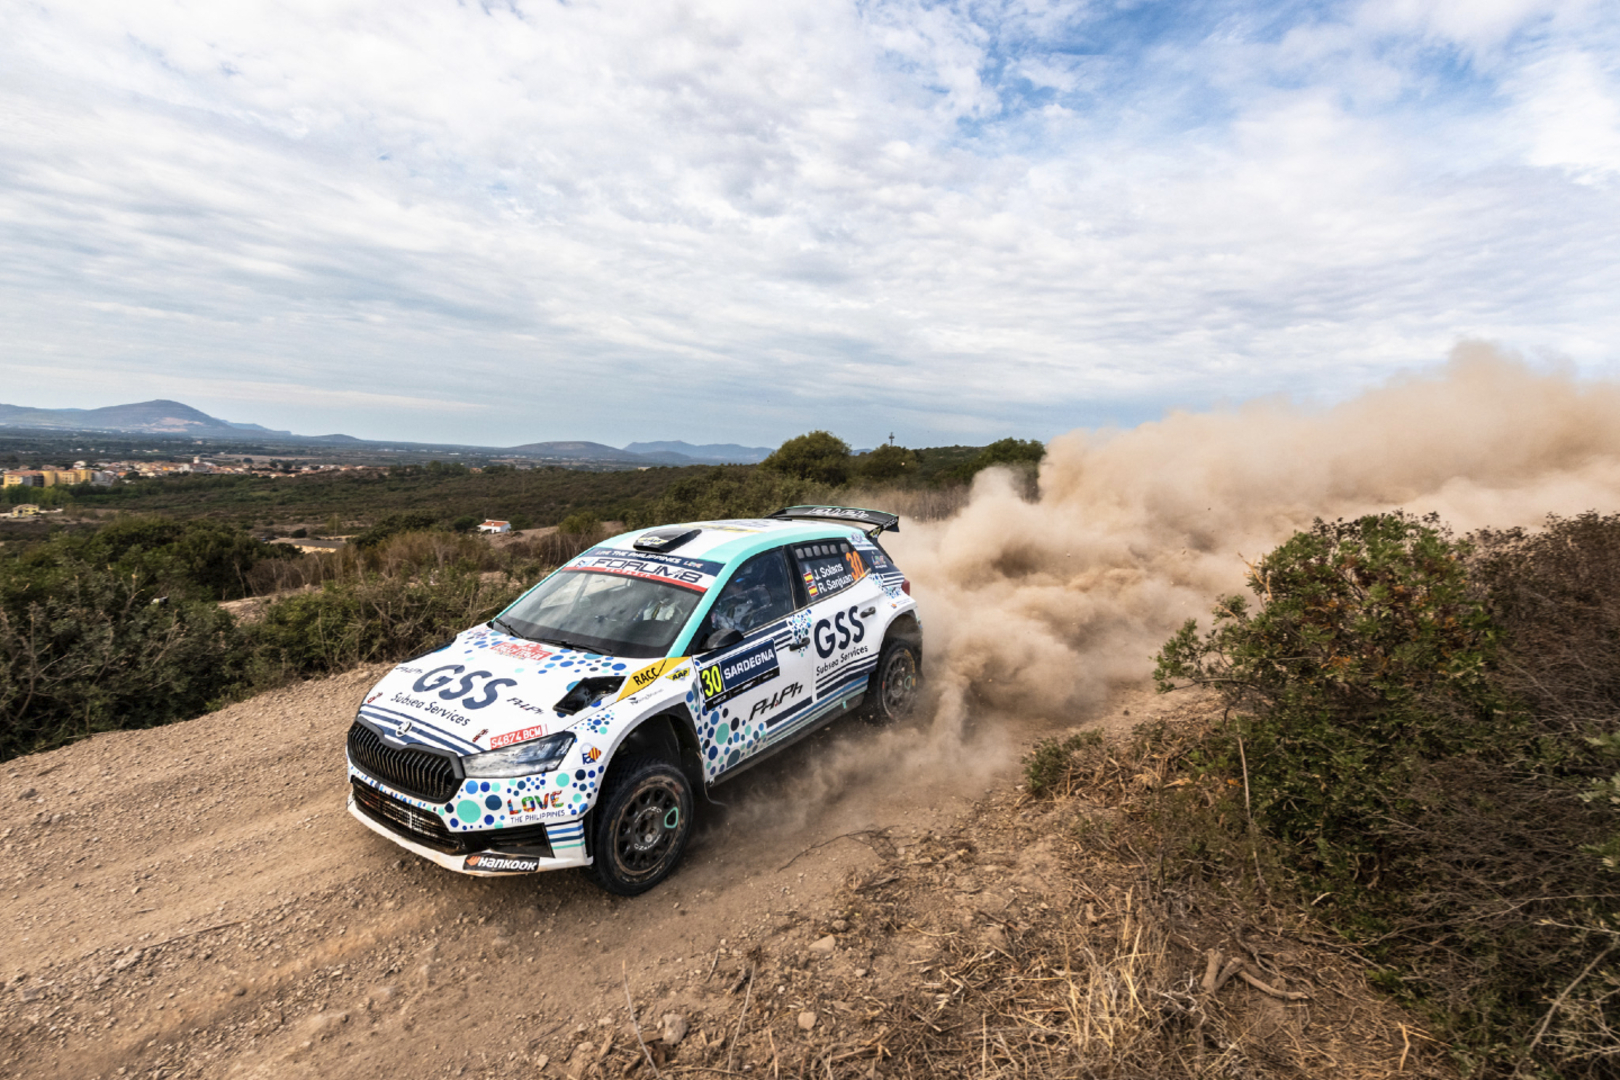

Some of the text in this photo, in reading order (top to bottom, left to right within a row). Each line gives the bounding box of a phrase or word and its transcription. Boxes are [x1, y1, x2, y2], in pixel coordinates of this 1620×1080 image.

[592, 558, 703, 583] FORUM8
[629, 552, 682, 564] PHILIPPINES
[820, 562, 844, 578] Solans
[845, 550, 866, 581] 30
[817, 573, 854, 594] R. Sanjuan
[814, 605, 865, 659] GSS
[723, 649, 775, 680] SARDEGNA
[815, 645, 869, 677] Subsea Services
[412, 664, 518, 710] GSS
[633, 667, 660, 686] RACC
[701, 665, 722, 697] 30
[390, 692, 426, 709] Subsea
[424, 701, 471, 727] Services
[507, 790, 565, 816] LOVE
[510, 809, 566, 824] THE PHILIPPINES
